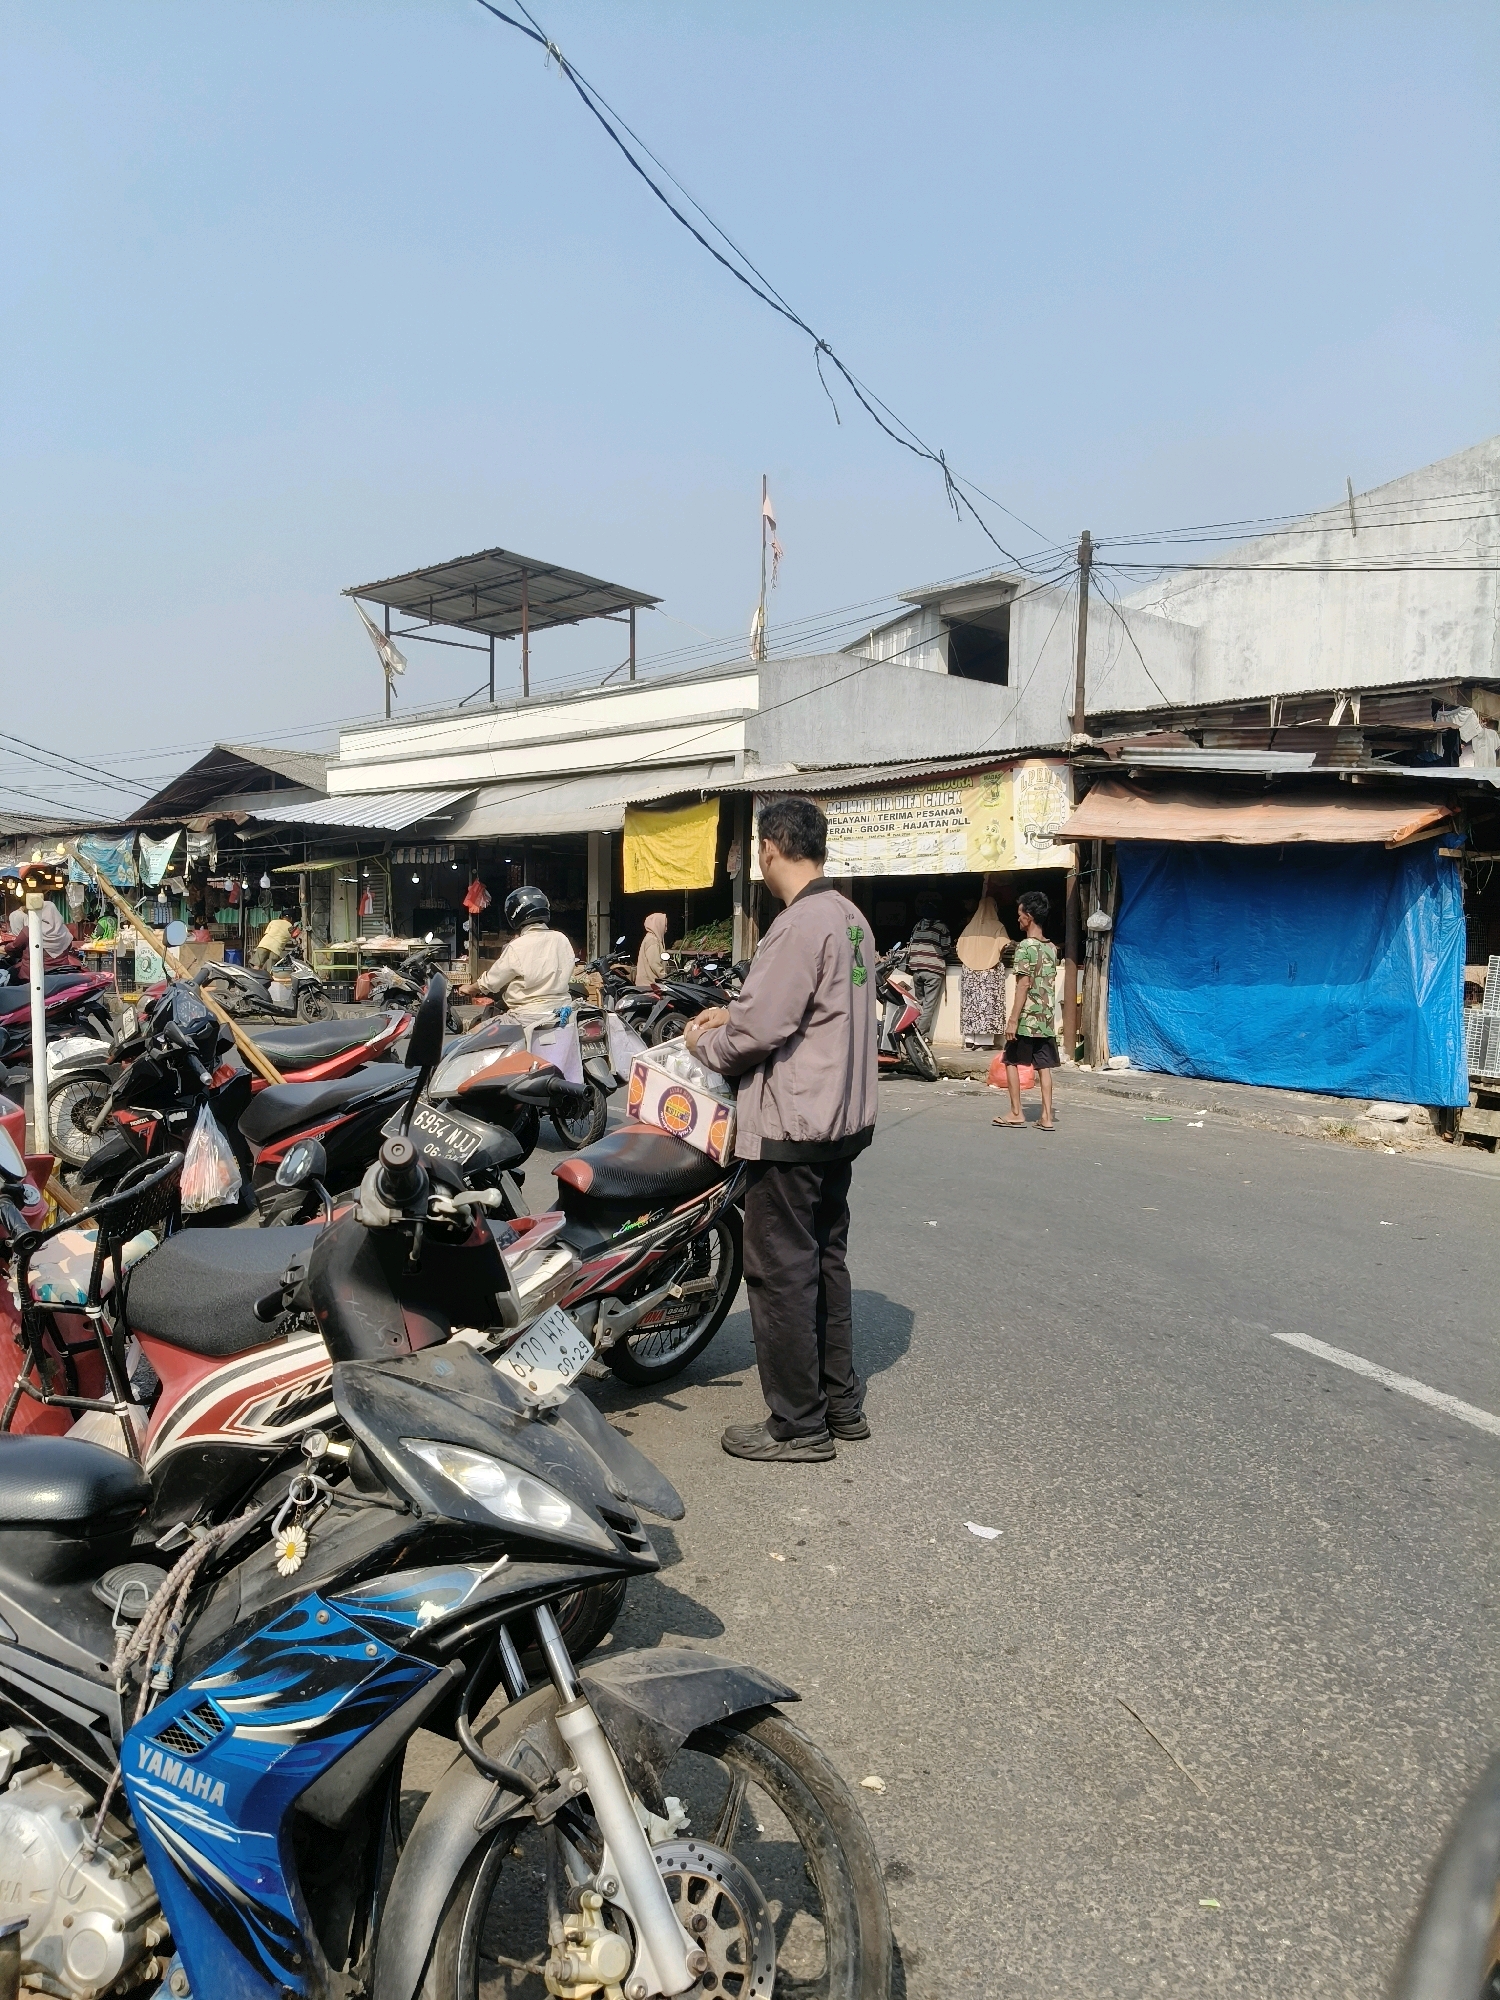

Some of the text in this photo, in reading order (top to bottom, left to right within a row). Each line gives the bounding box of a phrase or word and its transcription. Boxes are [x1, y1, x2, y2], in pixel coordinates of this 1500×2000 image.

[923, 790, 962, 808] CHICK
[878, 811, 913, 822] TERIMA
[916, 807, 963, 819] PESANAN
[860, 823, 895, 834] GROSIR
[903, 818, 949, 830] HAJATAN
[951, 817, 971, 826] DLL
[414, 1110, 476, 1154] 6954 NJJ
[138, 1742, 227, 1808] YAMAHA
